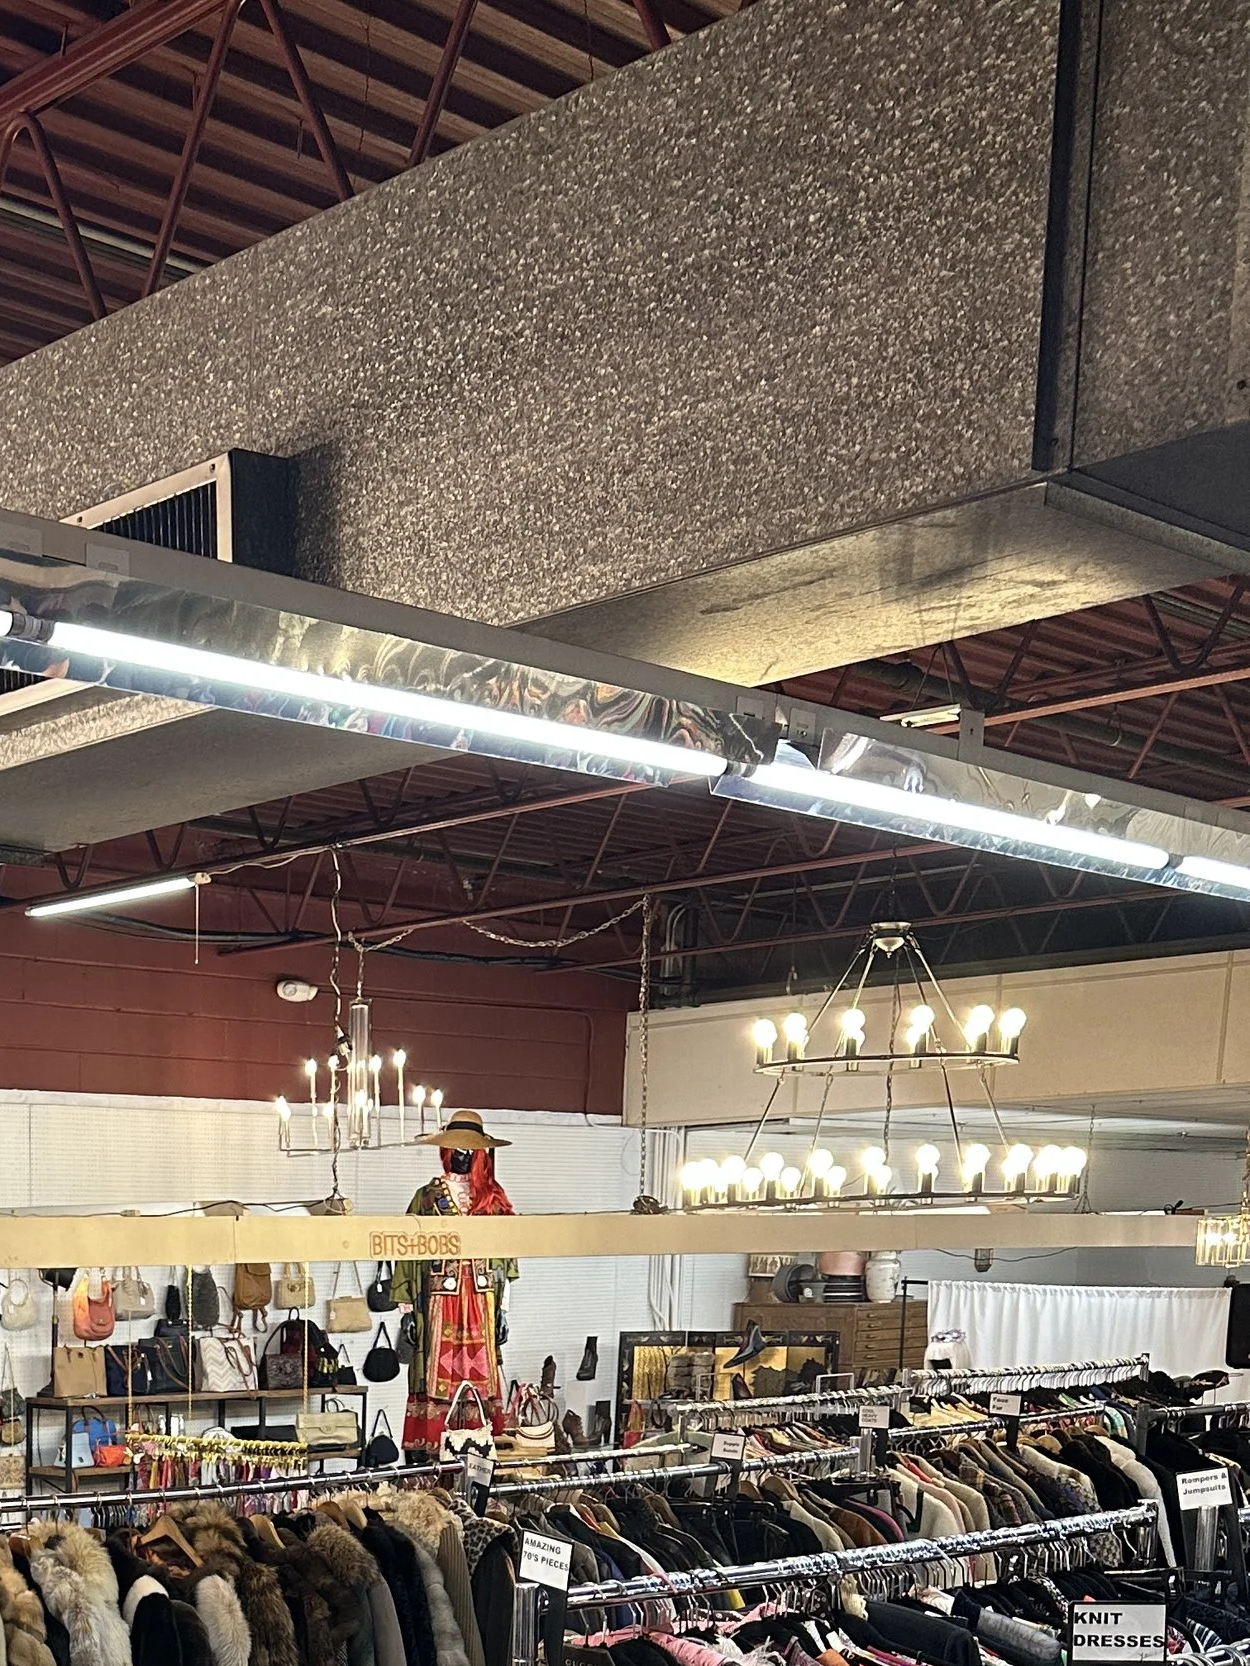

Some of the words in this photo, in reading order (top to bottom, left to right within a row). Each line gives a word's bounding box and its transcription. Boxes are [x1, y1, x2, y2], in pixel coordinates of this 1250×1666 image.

[371, 1234, 461, 1256] BITS+BOBS
[1181, 1474, 1219, 1484] Rompers
[1183, 1484, 1226, 1495] Jumpsuits
[524, 1537, 561, 1555] AMAZING
[523, 1551, 539, 1562] 70'S
[540, 1556, 569, 1571] PIECES
[1074, 1612, 1123, 1624] KNIT
[1073, 1634, 1165, 1647] DRESSES
